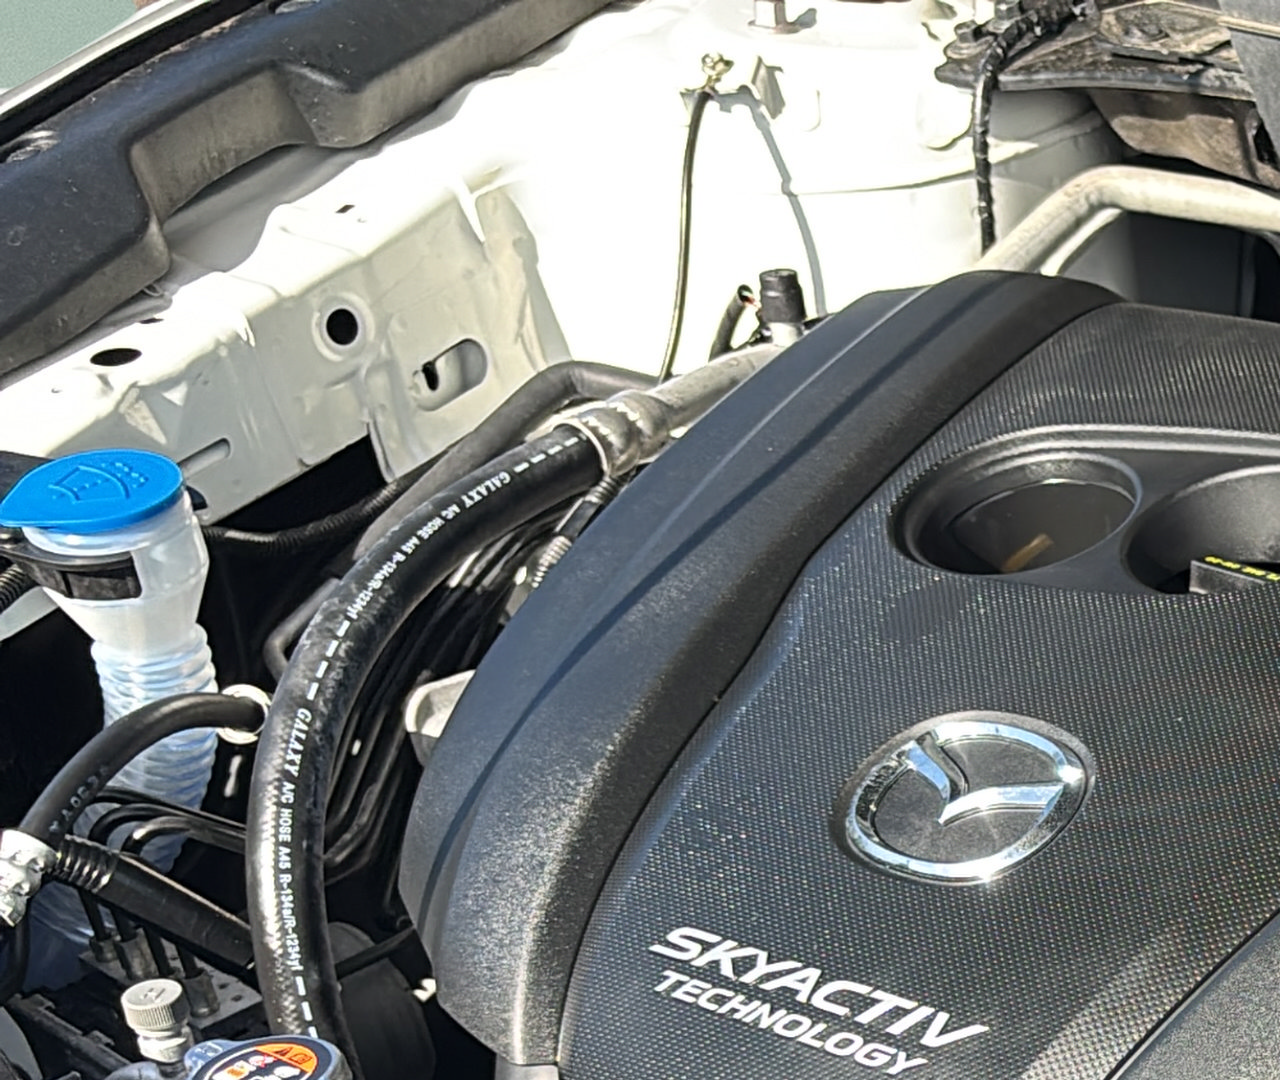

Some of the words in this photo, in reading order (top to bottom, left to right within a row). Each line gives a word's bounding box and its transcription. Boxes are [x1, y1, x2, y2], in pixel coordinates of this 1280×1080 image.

[461, 471, 510, 508] GALAXY
[416, 517, 445, 540] HOSE
[283, 708, 312, 778] GALAXY
[280, 780, 295, 804] A/C
[278, 807, 292, 843] HOSE
[278, 845, 292, 870] A45
[278, 873, 302, 971] R-134a/R-1234yf
[649, 926, 990, 1049] SKYACTIV
[653, 970, 929, 1076] TECHNOLOGY
